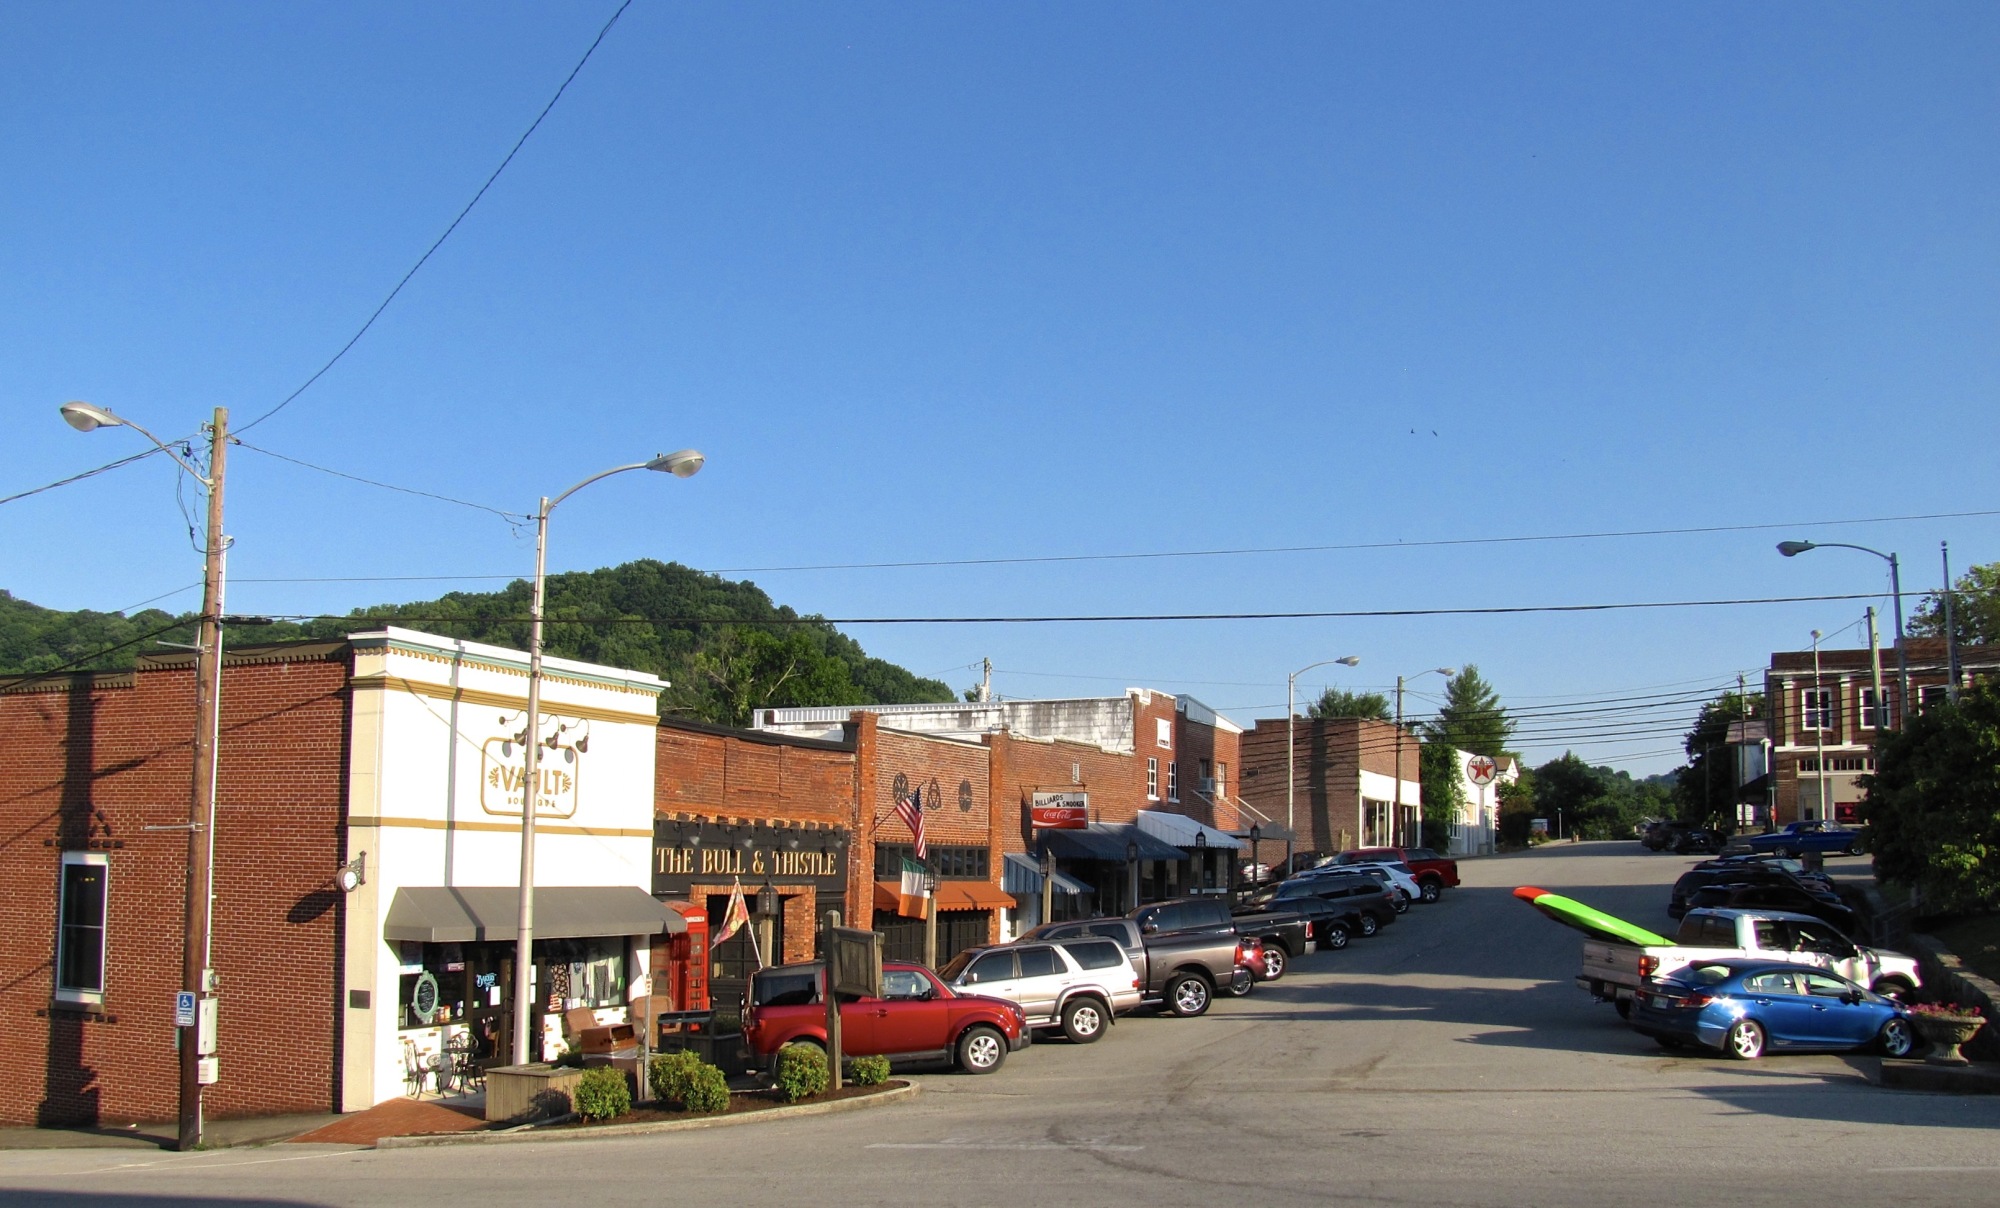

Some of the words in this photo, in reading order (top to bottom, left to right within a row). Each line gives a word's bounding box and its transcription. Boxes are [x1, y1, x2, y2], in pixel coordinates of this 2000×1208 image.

[507, 797, 556, 807] BOUQUE
[1035, 795, 1064, 807] BILLIARDS
[656, 848, 694, 874] THE
[701, 849, 746, 874] BULL
[752, 850, 765, 874] &
[772, 851, 836, 876] THISTLE
